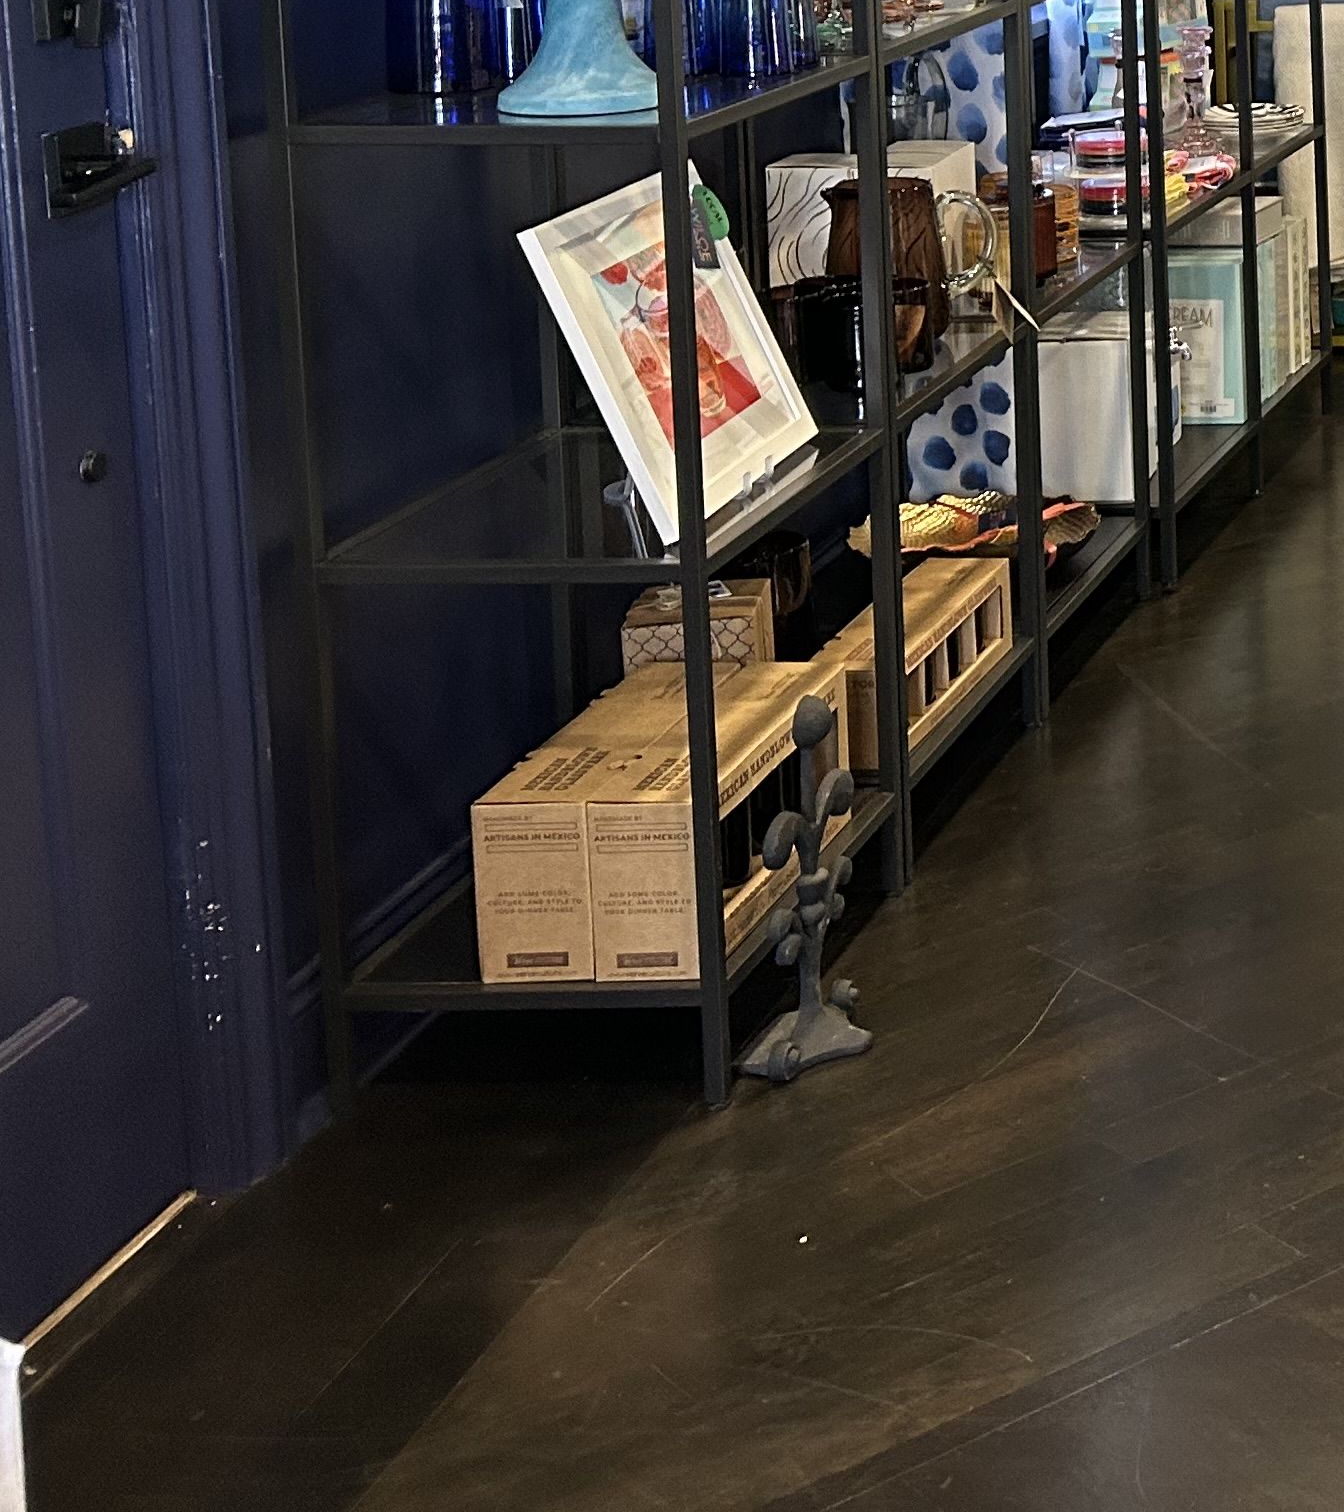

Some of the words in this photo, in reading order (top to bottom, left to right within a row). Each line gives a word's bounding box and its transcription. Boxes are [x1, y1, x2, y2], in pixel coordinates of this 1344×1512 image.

[1170, 307, 1213, 328] REAM
[484, 833, 529, 842] ARTISANS
[531, 833, 542, 841] IN
[543, 832, 580, 841] MEXICO
[594, 833, 639, 842] ARTISANS
[641, 833, 651, 841] IN
[653, 832, 690, 842] MEXICO
